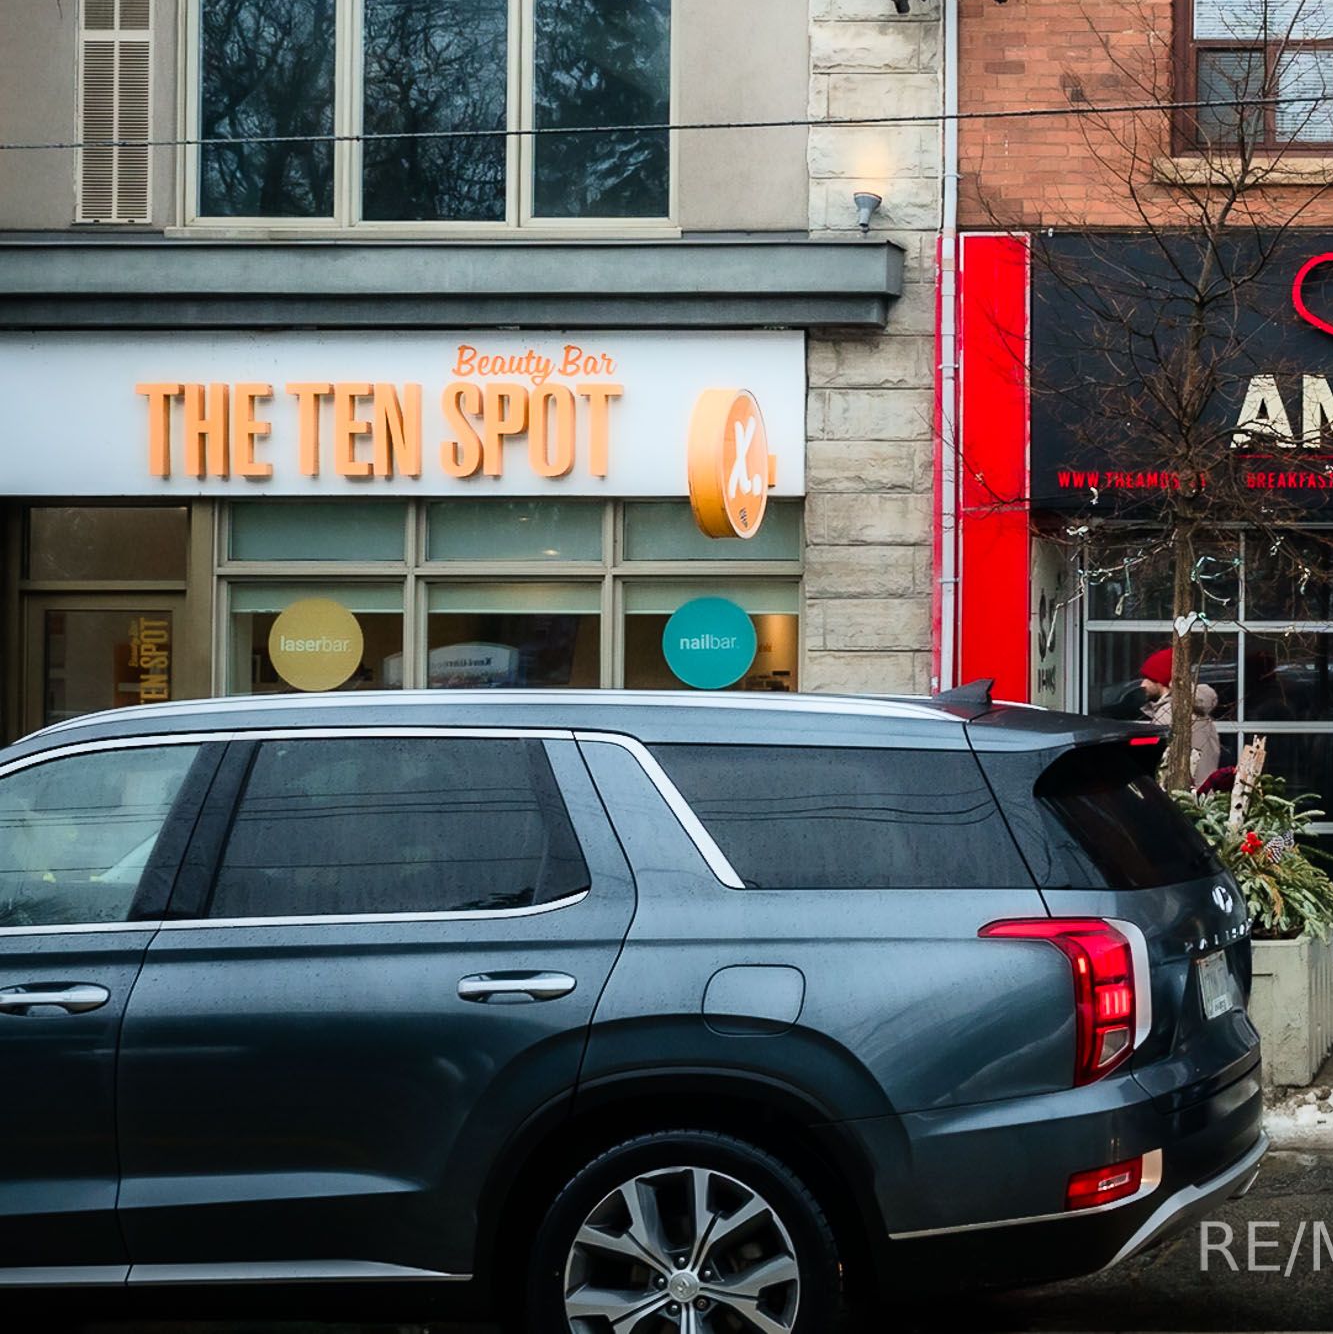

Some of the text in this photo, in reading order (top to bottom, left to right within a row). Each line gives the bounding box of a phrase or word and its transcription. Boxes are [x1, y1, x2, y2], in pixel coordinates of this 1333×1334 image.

[452, 345, 617, 386] Beauty Bar
[135, 382, 624, 479] THE TEN SPOT
[140, 617, 168, 669] SPOT
